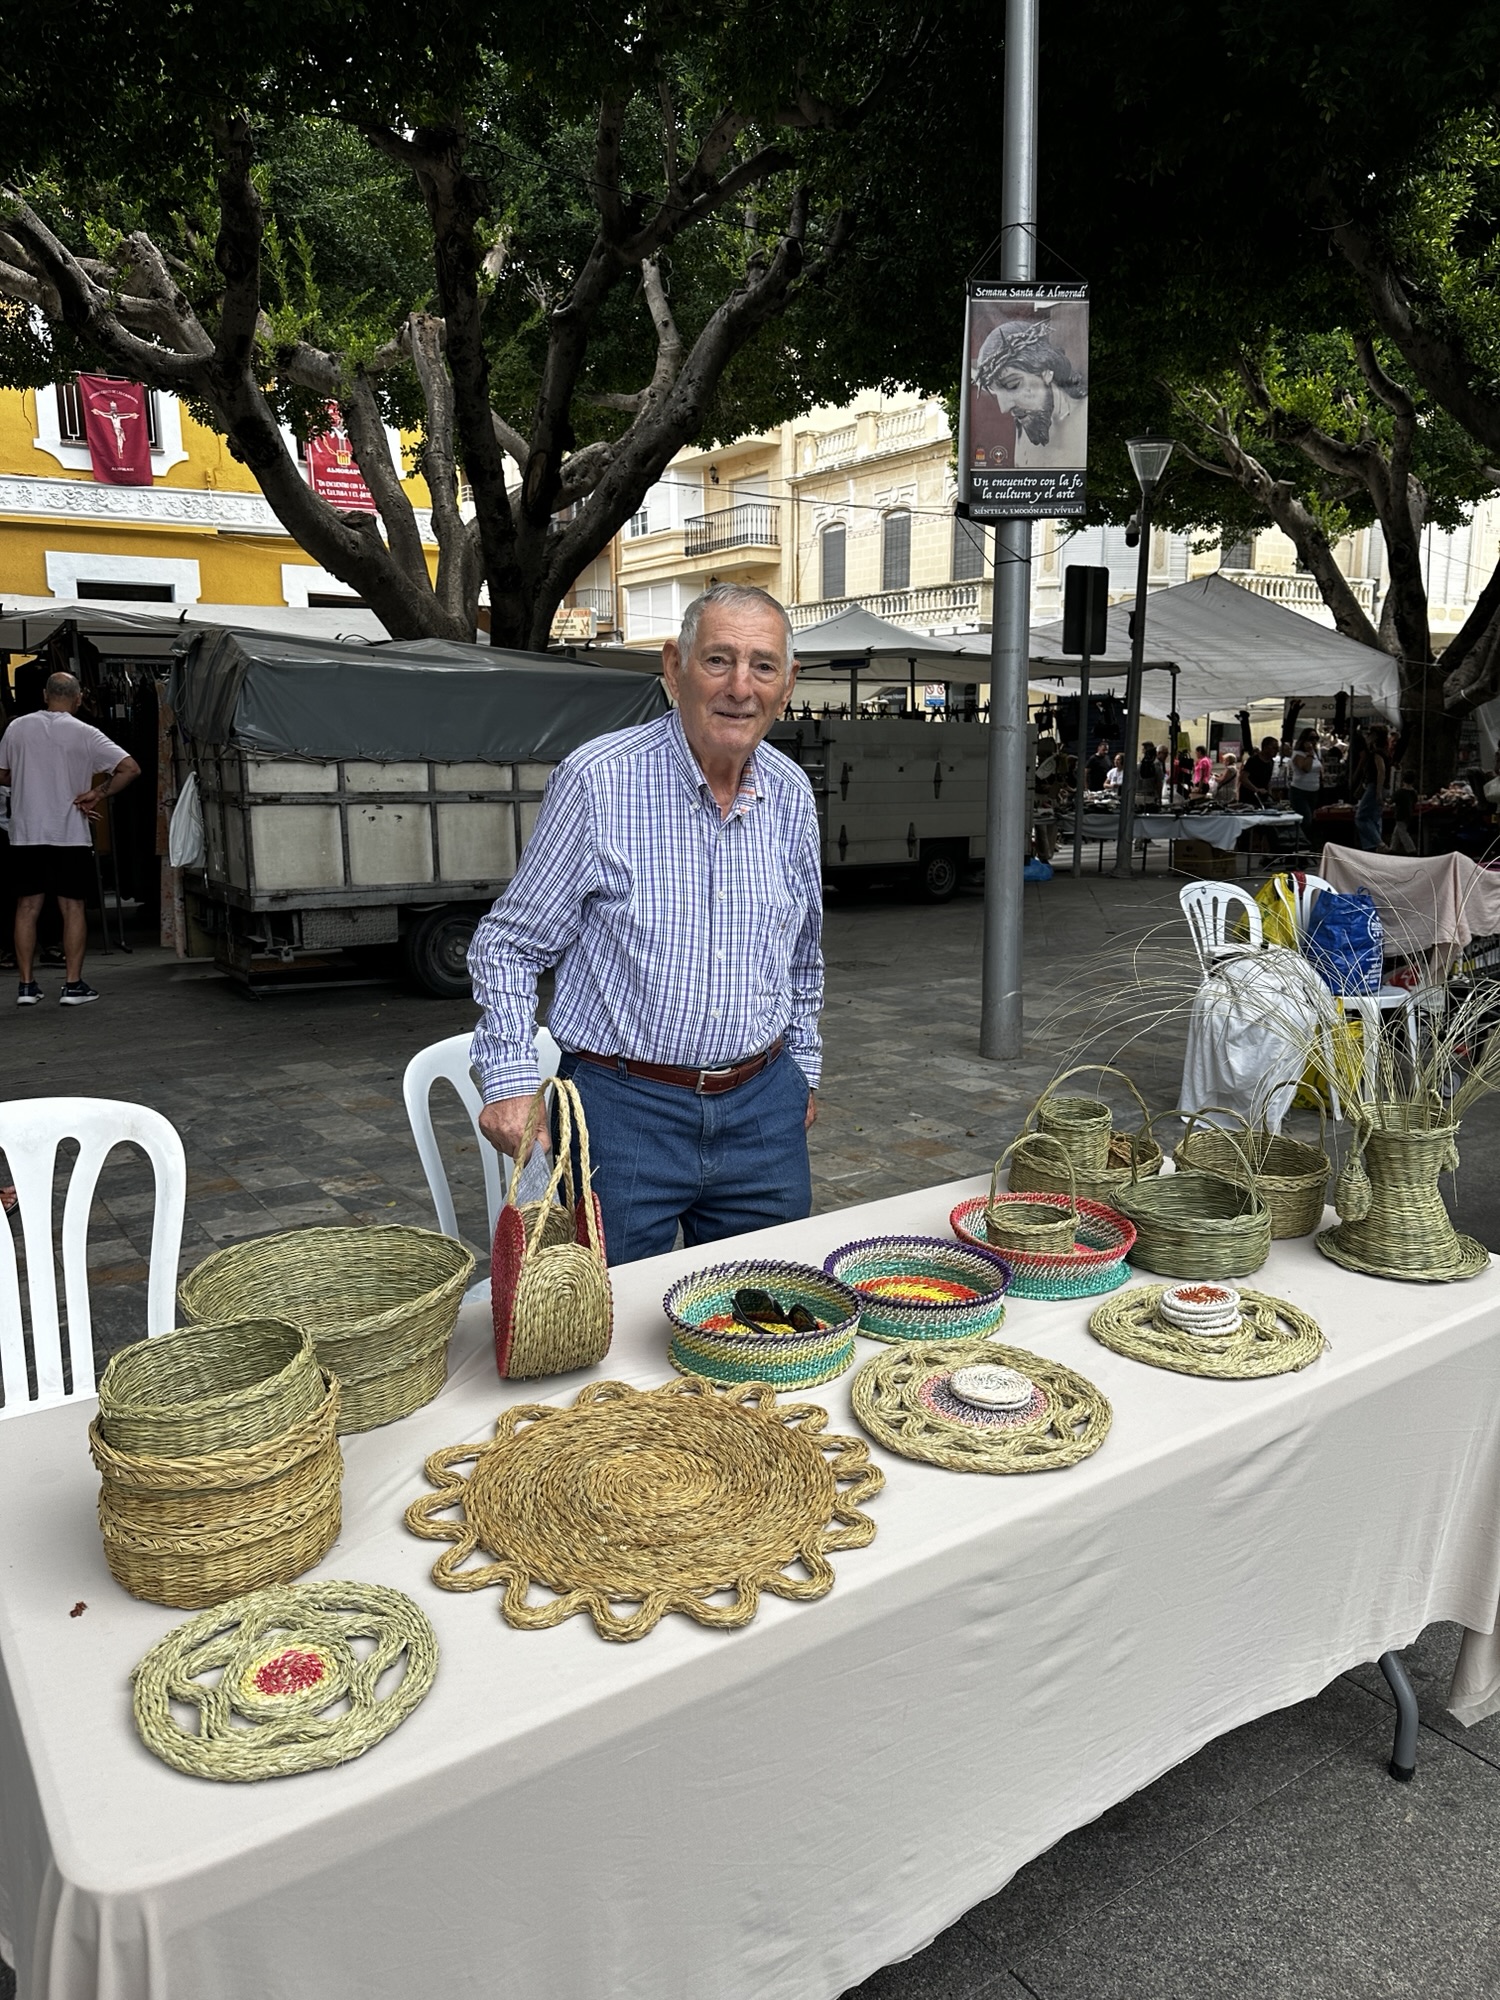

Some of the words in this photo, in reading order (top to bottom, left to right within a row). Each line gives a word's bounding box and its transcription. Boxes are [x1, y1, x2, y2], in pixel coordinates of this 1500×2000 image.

[976, 287, 1007, 297] Semana
[1010, 288, 1033, 297] Santa
[1036, 285, 1045, 297] de
[1047, 284, 1088, 298] Almoradí
[326, 467, 360, 475] ALMORAD
[973, 478, 989, 487] Un
[992, 477, 1037, 487] encuentro
[1040, 478, 1055, 486] con
[1059, 474, 1069, 486] la
[1068, 474, 1084, 490] fe,
[982, 487, 992, 499] la
[995, 487, 1031, 499] cultura
[1029, 492, 1042, 504] y
[1044, 487, 1055, 499] el
[1056, 490, 1076, 499] arte
[974, 506, 1008, 515] SIÉNTELA,
[1010, 506, 1052, 515] EMOCIÓNATE
